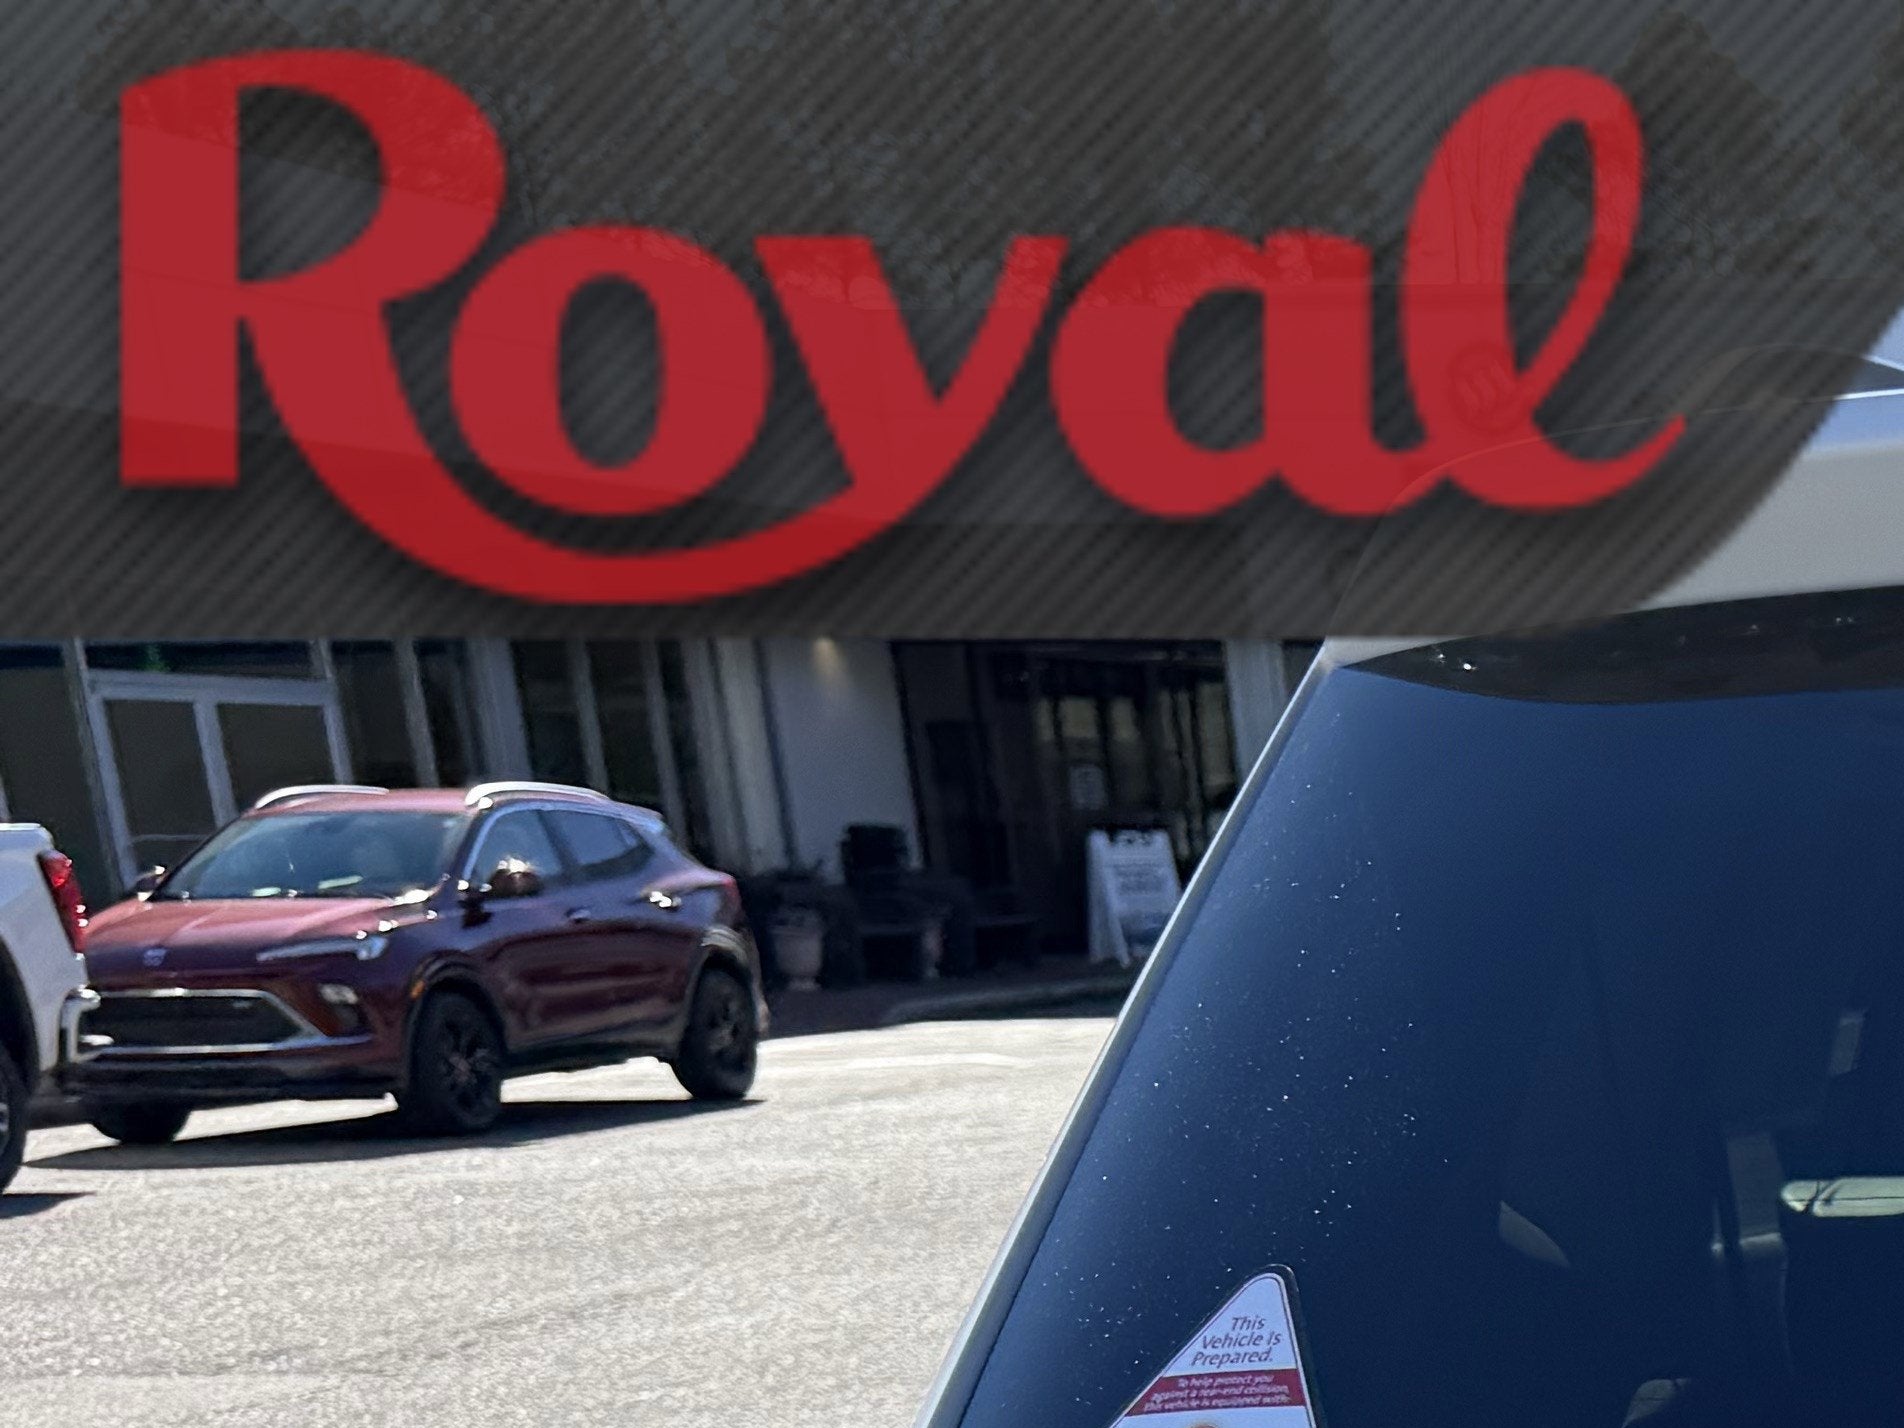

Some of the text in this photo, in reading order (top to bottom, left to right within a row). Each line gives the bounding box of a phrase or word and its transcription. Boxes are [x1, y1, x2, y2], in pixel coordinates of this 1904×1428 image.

[1231, 1315, 1266, 1331] This
[1202, 1331, 1264, 1350] Vehicle
[1190, 1347, 1274, 1369] Prepared.
